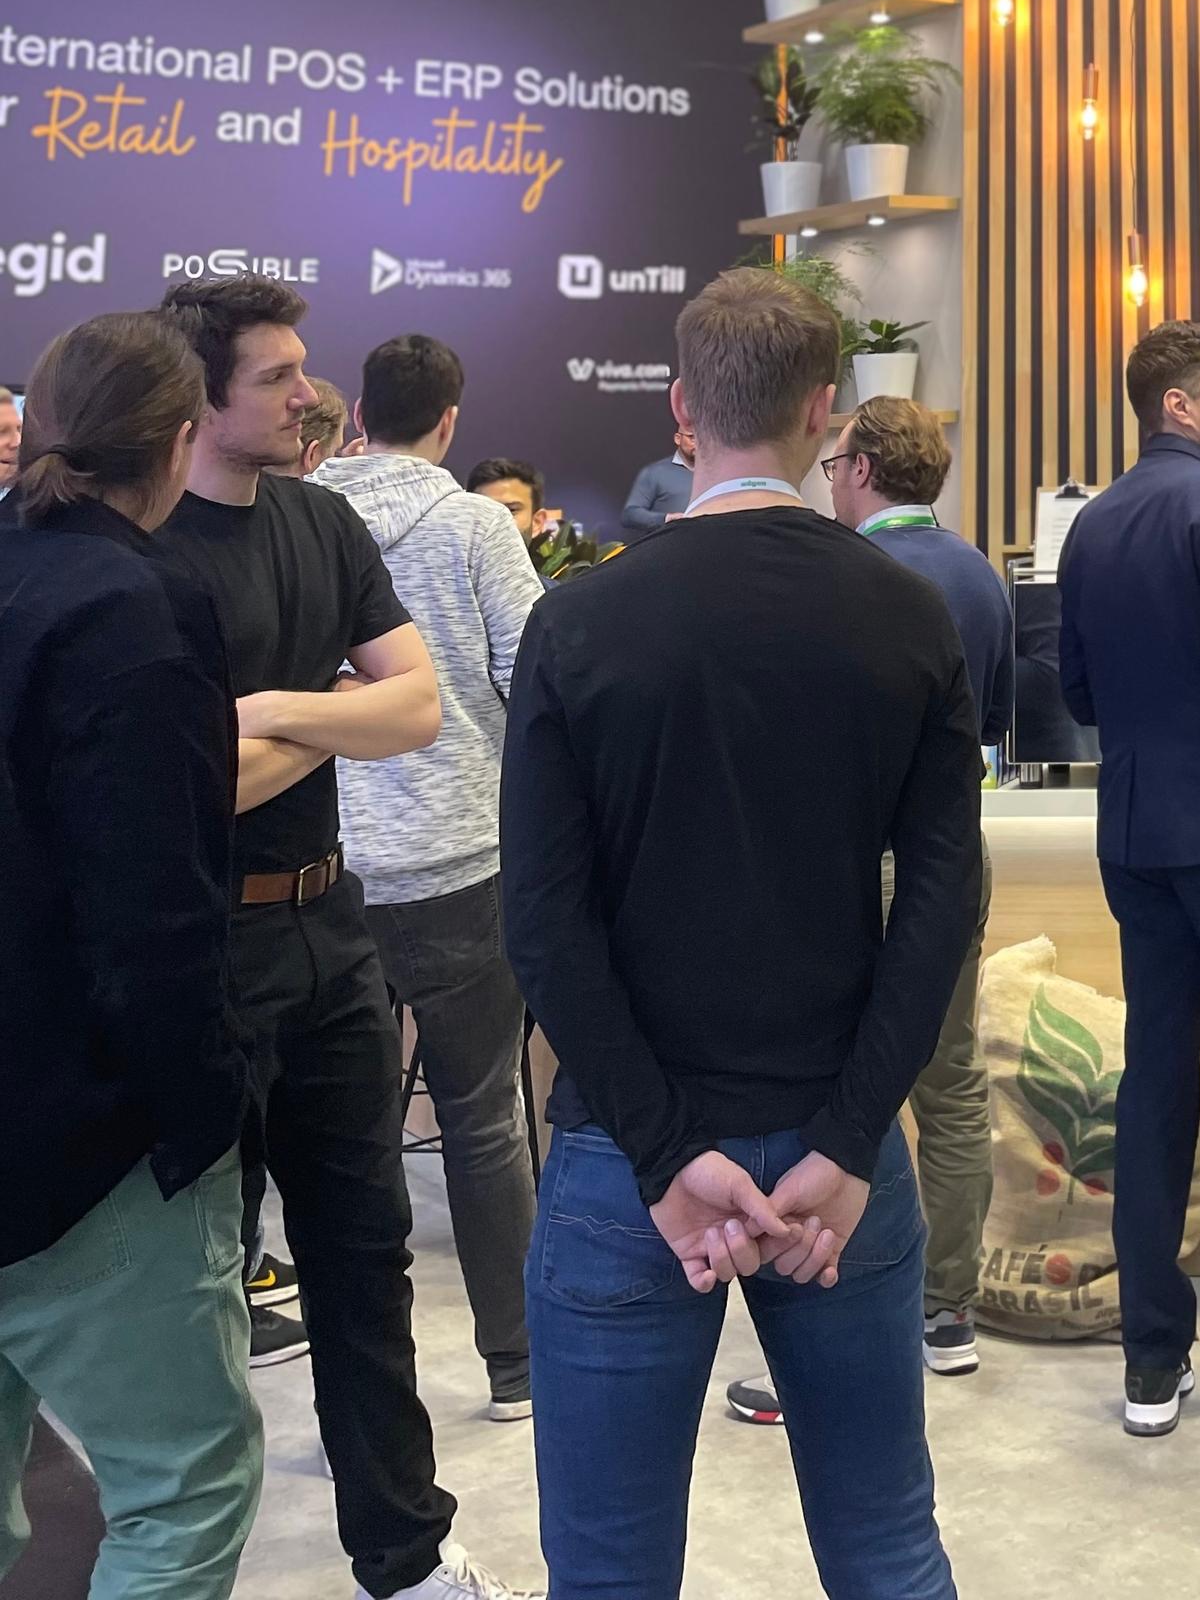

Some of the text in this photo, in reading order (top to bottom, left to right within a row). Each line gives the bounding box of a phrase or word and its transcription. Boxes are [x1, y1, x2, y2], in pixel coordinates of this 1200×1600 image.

[267, 47, 367, 92] POS
[377, 67, 403, 93] +
[414, 59, 503, 101] ERP
[513, 67, 691, 116] Solutions
[31, 82, 196, 160] Retail
[216, 107, 302, 146] and
[320, 107, 564, 213] Hospitality
[0, 232, 106, 297] gid
[609, 265, 685, 293] unTill
